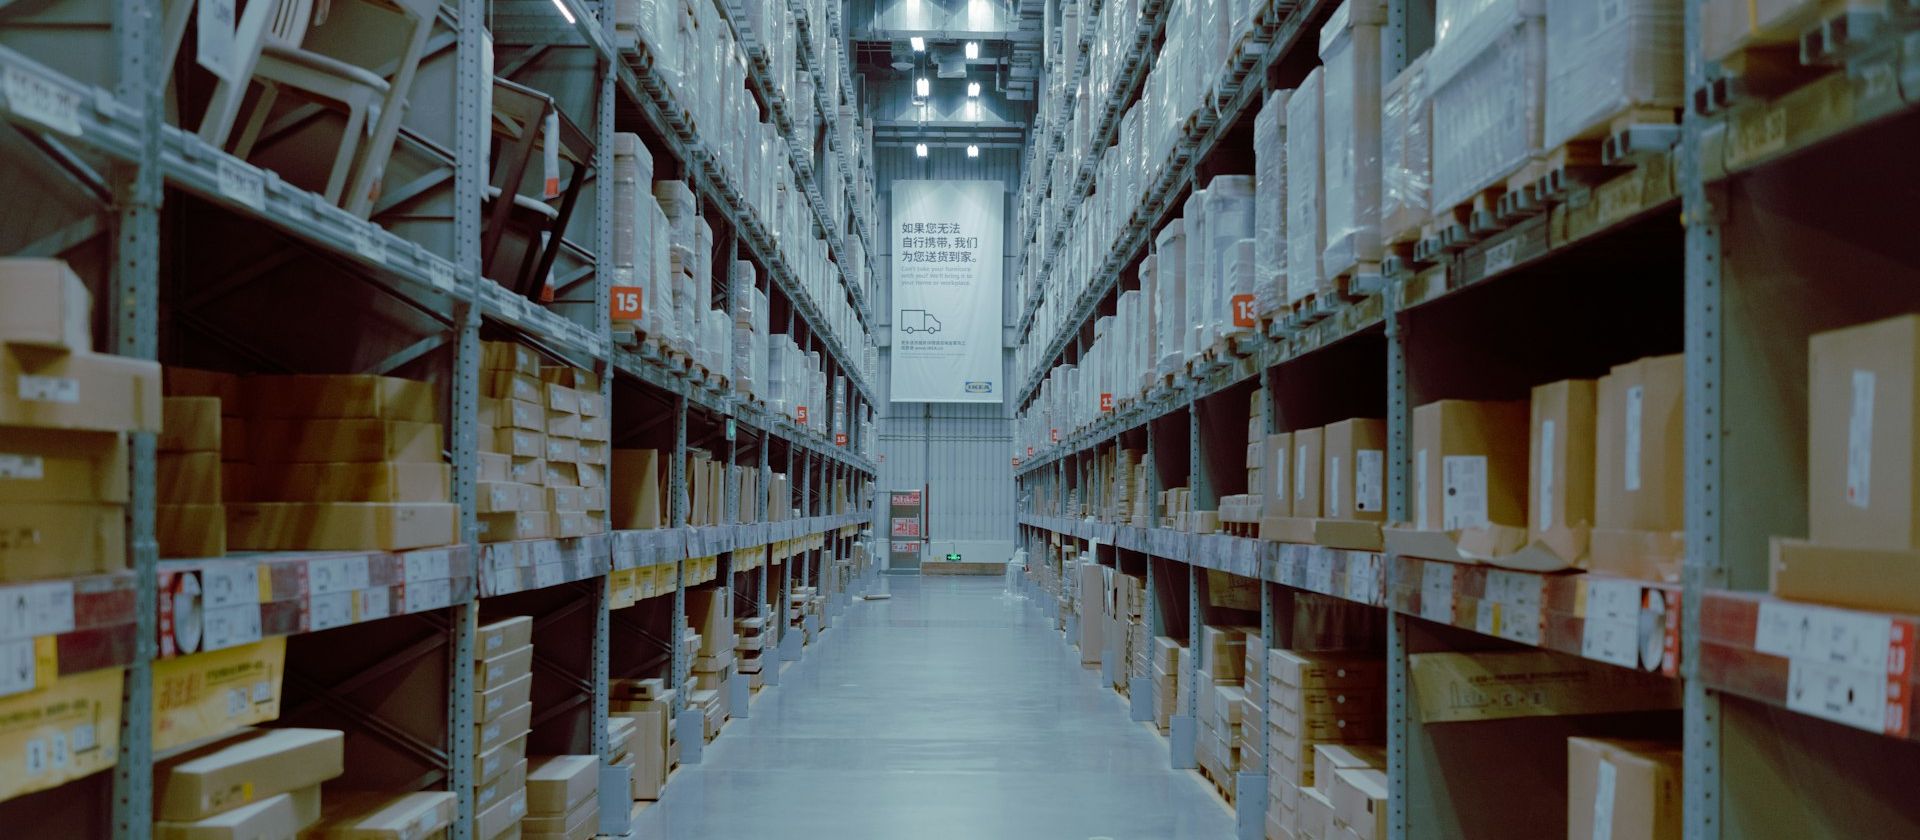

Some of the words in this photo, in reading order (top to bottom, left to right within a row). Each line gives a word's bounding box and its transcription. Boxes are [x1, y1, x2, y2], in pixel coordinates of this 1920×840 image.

[902, 222, 960, 234] 如果您无法
[902, 250, 977, 263] 为您送货到家。
[616, 292, 638, 312] 15
[1238, 301, 1256, 320] 13
